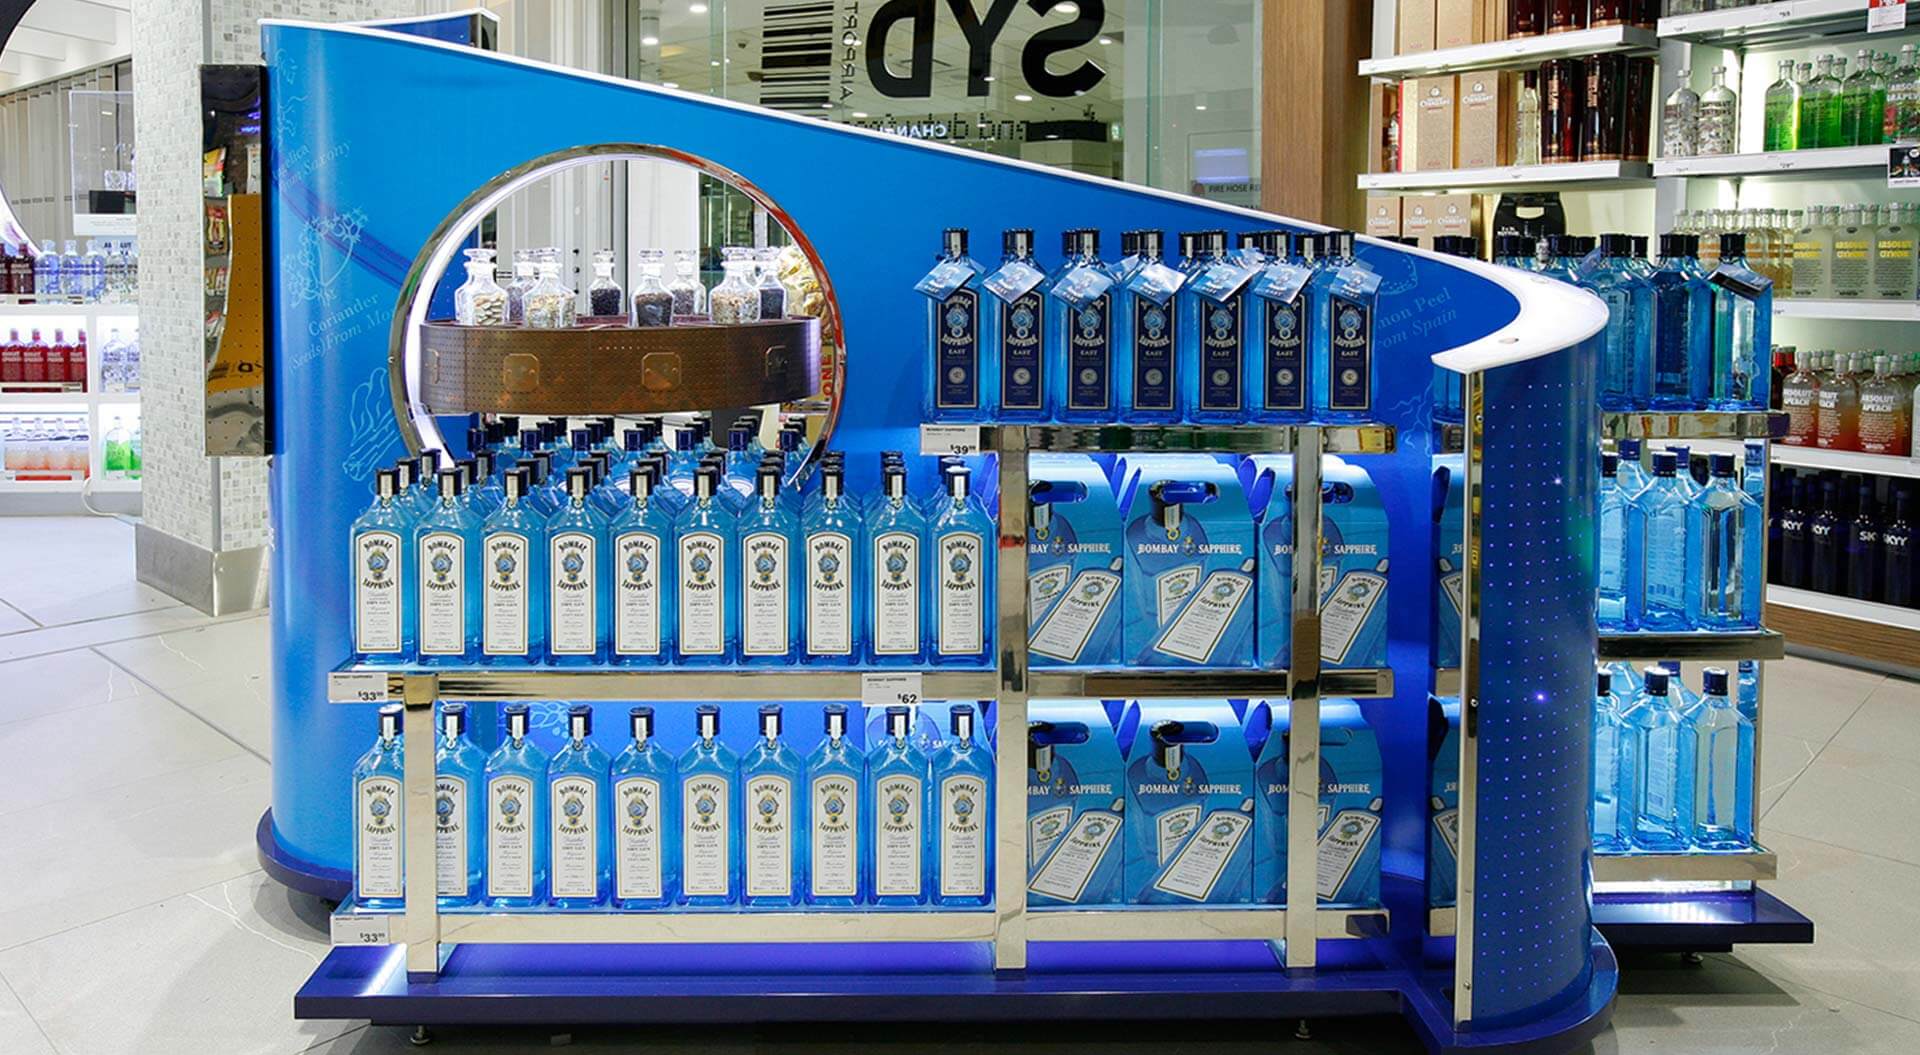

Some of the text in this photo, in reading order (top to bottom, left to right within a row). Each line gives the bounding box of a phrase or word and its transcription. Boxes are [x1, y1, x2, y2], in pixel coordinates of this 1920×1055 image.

[1226, 184, 1248, 192] HOSE
[1249, 184, 1261, 192] RE
[1878, 240, 1912, 249] ABSOLUT
[1413, 287, 1453, 313] Peel
[308, 294, 379, 336] Coriander
[1412, 309, 1457, 337] Spain
[1861, 393, 1895, 404] ABSOLUT
[1859, 531, 1877, 541] SK
[363, 539, 393, 551] BOMBAY
[427, 540, 456, 552] BOMBAY
[491, 540, 520, 552] BOMBAY
[558, 540, 587, 552] BOMBAY
[623, 540, 652, 552] BOMBAY
[686, 540, 716, 552] BOMBAY
[751, 540, 780, 552] BOMBAY
[815, 540, 844, 552] BOMBAY
[882, 540, 911, 552] BOMBAY
[946, 540, 975, 552] BOMBAY
[1030, 543, 1112, 554] BAY SAPPHIRE
[1137, 543, 1242, 555] BOMBAY SAPPHIRE
[1334, 543, 1377, 555] SAPPHIRE
[362, 578, 394, 589] SAPPHIRE
[426, 579, 457, 592] SAPPHIRE
[490, 579, 521, 592] SAPPHIRE
[557, 579, 588, 592] SAPPHIRE
[622, 579, 653, 592] SAPPHIRE
[685, 579, 717, 592] SAPPHIRE
[750, 579, 781, 592] SAPPHIRE
[813, 579, 845, 592] SAPPHIRE
[881, 579, 912, 592] SAPPHIRE
[945, 579, 976, 592] SAPPHIRE
[366, 784, 395, 796] BOMBAY
[436, 783, 459, 796] OMBAY
[496, 783, 525, 795] BOMBAY
[559, 784, 588, 796] BOMBAY
[623, 784, 652, 797] BOMBAY
[691, 783, 720, 795] BOMBAY
[754, 783, 782, 795] BOMBAY
[820, 783, 849, 795] BOMBAY
[884, 783, 913, 795] BOMBAY
[949, 783, 978, 795] BOMBAY
[1069, 784, 1112, 795] SAPPHIRE
[1138, 784, 1242, 795] BOMBAY SAPPHIRE
[1327, 783, 1371, 794] SAPPHIRE
[365, 824, 396, 835] SAPPHIRE
[495, 824, 526, 834] SAPPHIRE
[558, 824, 589, 835] SAPPHIRE
[622, 825, 653, 836] SAPPHIRE
[690, 822, 721, 832] SAPPHIRE
[753, 822, 783, 833] SAPPHIRE
[819, 822, 850, 833] SAPPHIRE
[883, 822, 914, 833] SAPPHIRE
[948, 822, 979, 833] SAPPHIRE
